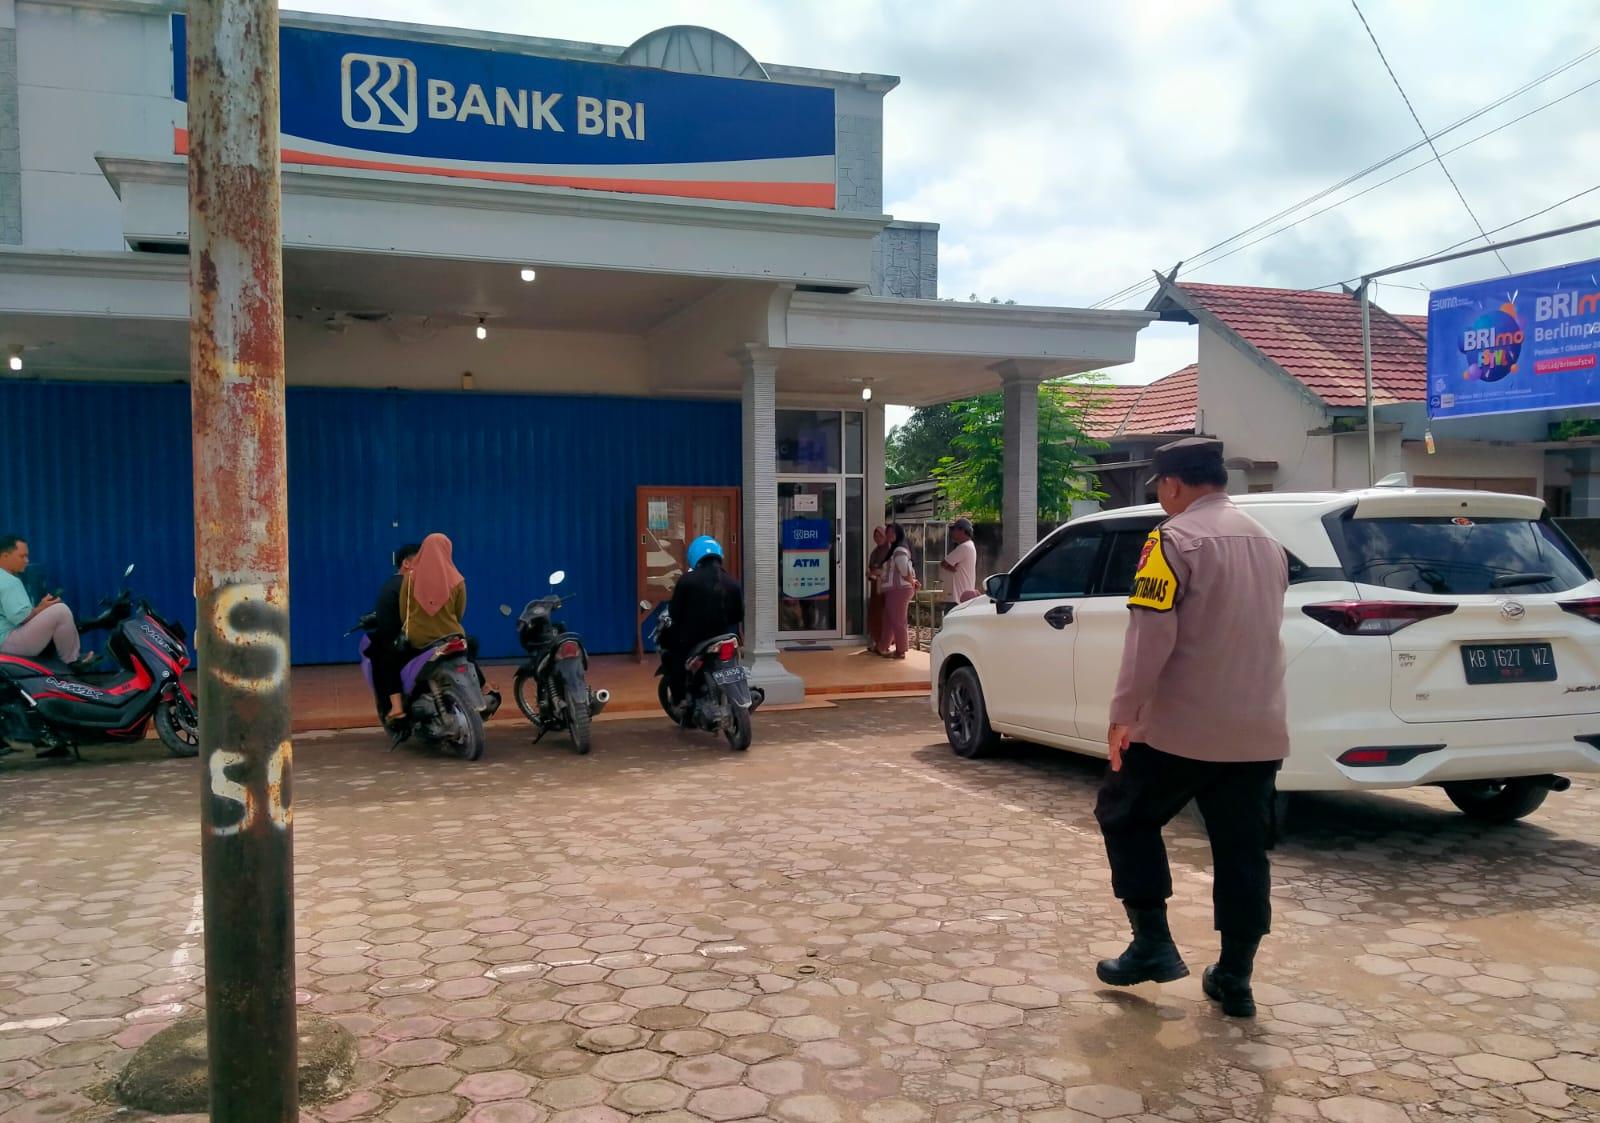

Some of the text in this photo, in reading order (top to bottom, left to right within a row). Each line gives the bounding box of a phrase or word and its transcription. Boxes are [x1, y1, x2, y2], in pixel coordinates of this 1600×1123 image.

[427, 78, 645, 141] BANK BRI
[1463, 327, 1524, 351] BRImo
[803, 529, 819, 539] BRI
[793, 558, 820, 568] ATM
[1469, 647, 1550, 668] KB 1627 WZ
